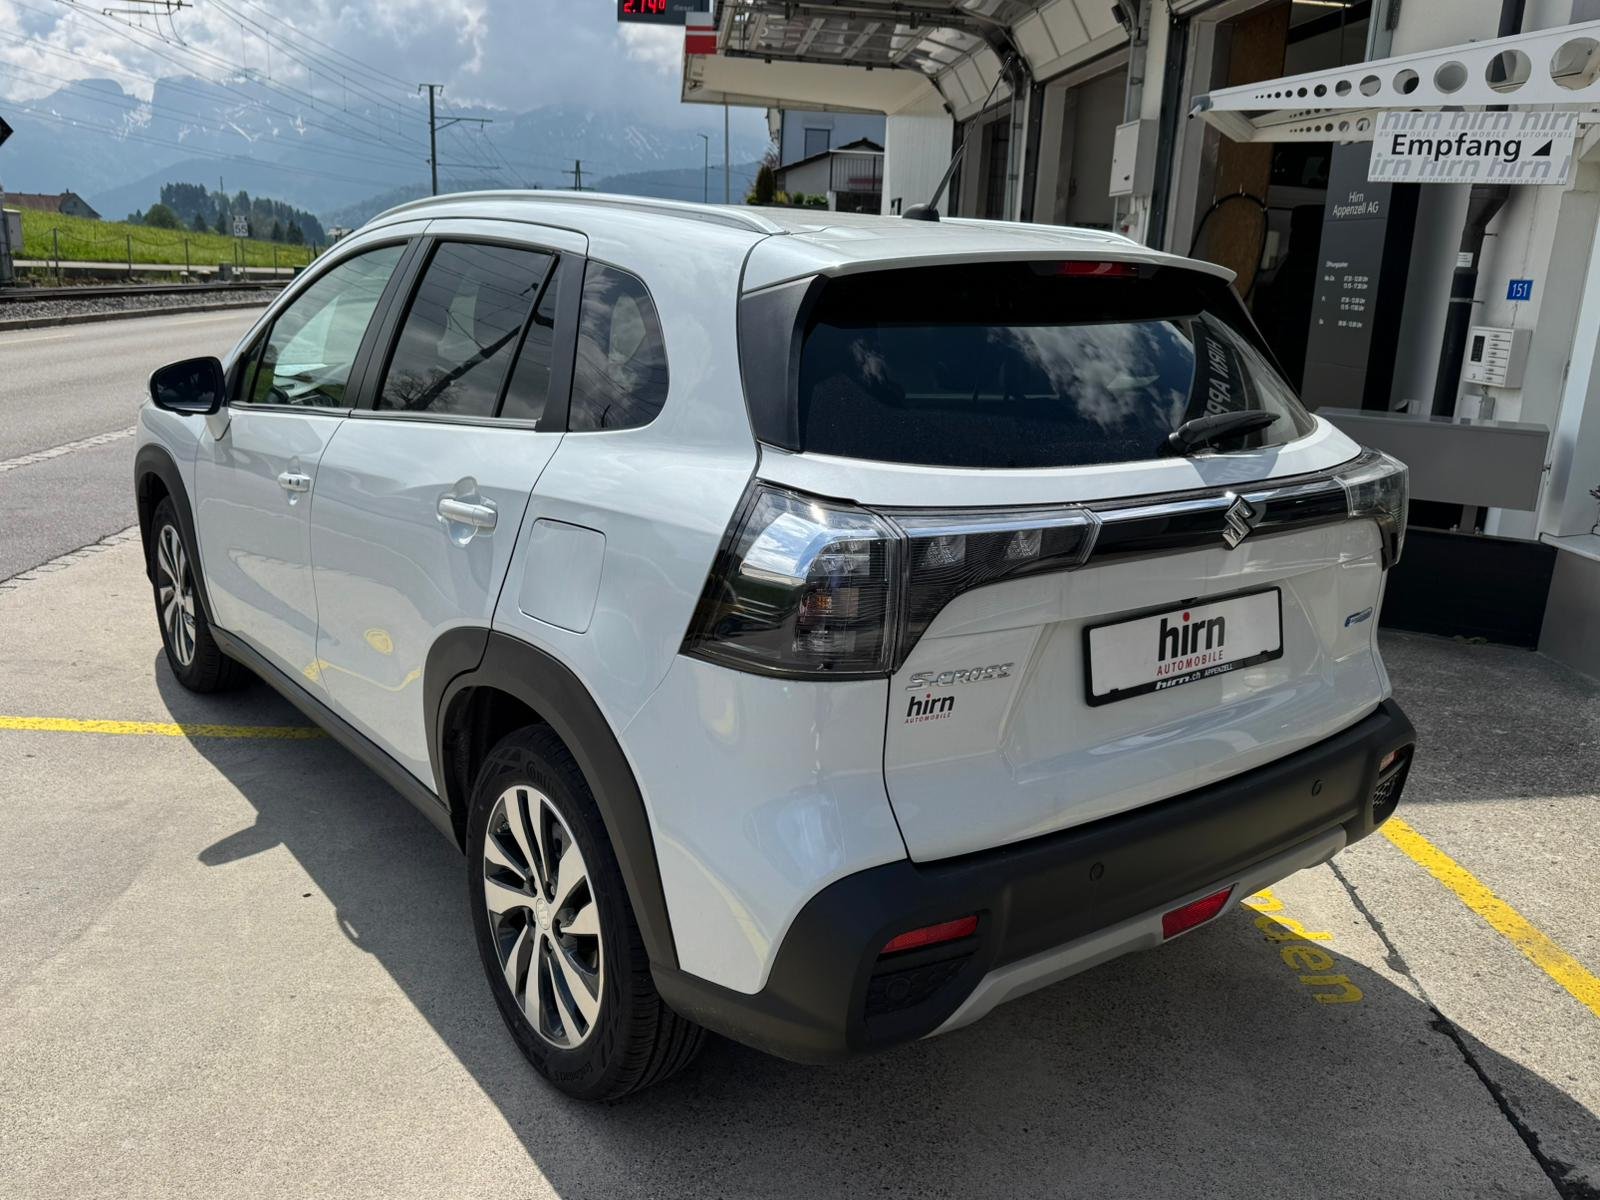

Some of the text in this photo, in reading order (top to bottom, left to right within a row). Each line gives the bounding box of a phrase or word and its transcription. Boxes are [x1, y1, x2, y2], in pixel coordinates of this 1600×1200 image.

[1391, 132, 1522, 163] Empfang
[1333, 201, 1379, 218] Appenzell AG
[1349, 191, 1364, 202] Hirn
[1512, 283, 1528, 297] 151
[1157, 611, 1225, 661] hirn
[1157, 650, 1224, 676] AUTOMOBILE
[905, 662, 1014, 691] S-CROSS
[1155, 663, 1233, 690] hirn.ch APPENZELL
[905, 712, 952, 724] AUTOMOBILE
[907, 693, 955, 717] hirn
[1241, 888, 1364, 1004] nden
